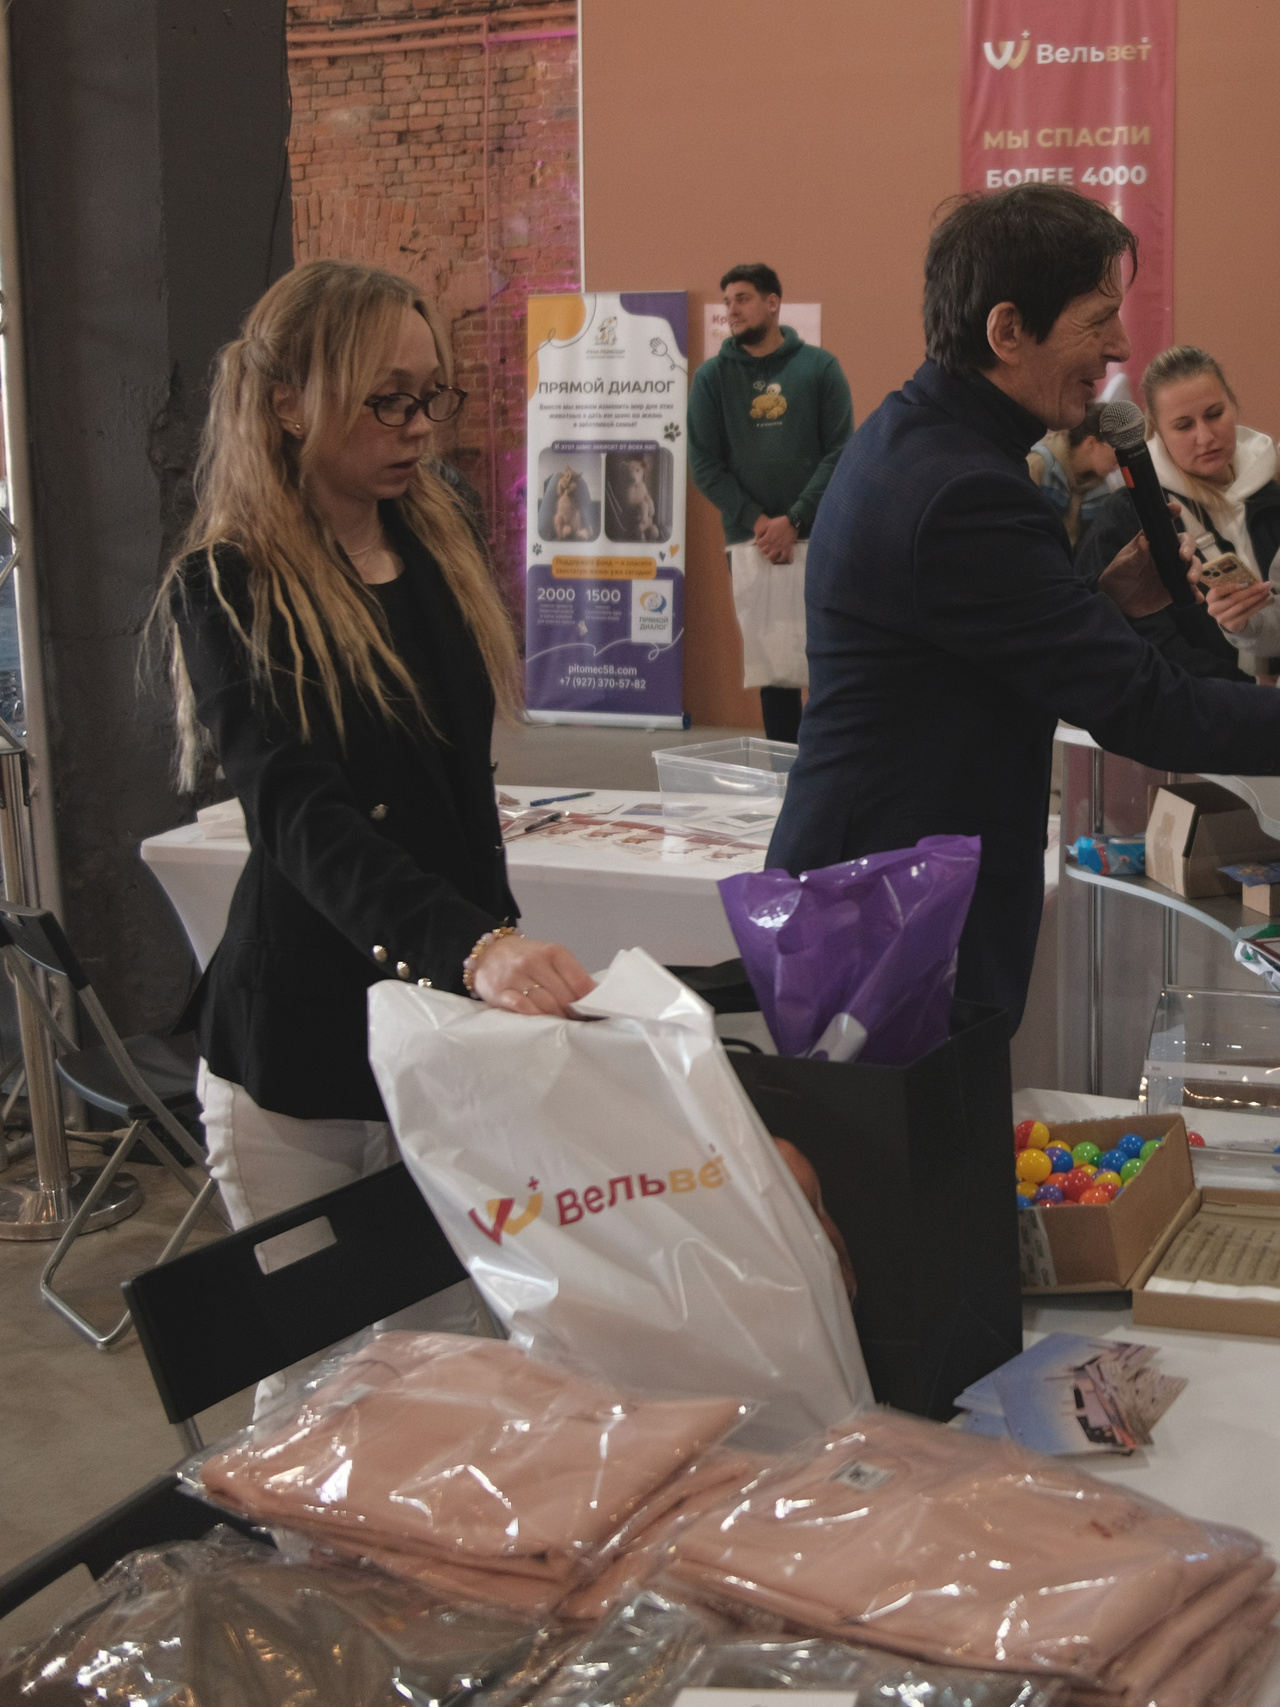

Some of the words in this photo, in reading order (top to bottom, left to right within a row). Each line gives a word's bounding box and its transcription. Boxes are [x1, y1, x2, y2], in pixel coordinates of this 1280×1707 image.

[1036, 40, 1152, 65] Вельвет
[983, 129, 1030, 150] МЫ
[1036, 125, 1151, 148] СПАСЛИ
[986, 167, 1074, 189] БОЛЕЕ
[1081, 165, 1147, 187] 4000
[538, 378, 604, 394] ПРЯМОЙ
[608, 380, 675, 395] ДИАЛОГ
[537, 588, 576, 601] 2000
[586, 589, 621, 602] 1500
[639, 616, 669, 624] ПРЯМОЙ
[568, 664, 638, 675] pitomec58.com
[559, 678, 570, 687] +7
[572, 678, 596, 689] (927)
[598, 679, 646, 690] 370-57-82
